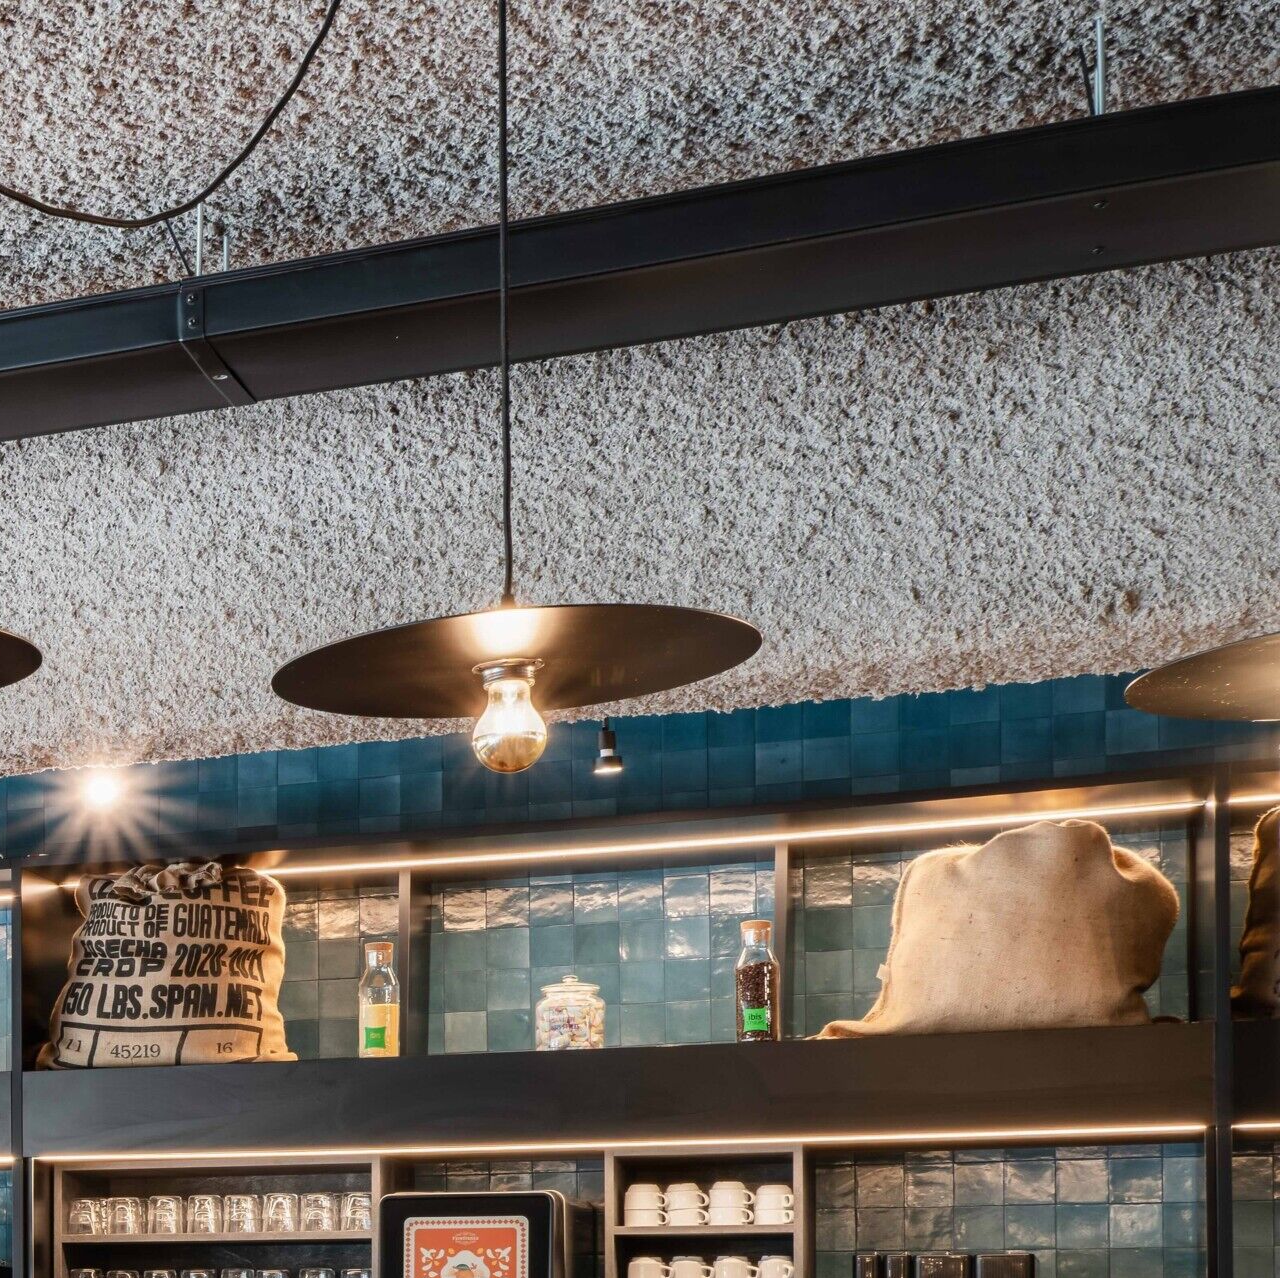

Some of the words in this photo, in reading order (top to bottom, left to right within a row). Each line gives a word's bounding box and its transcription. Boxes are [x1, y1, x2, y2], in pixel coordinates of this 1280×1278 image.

[79, 920, 140, 937] PRODUCT
[143, 921, 169, 938] OF
[89, 902, 140, 921] PRODUCTO
[144, 904, 170, 921] DE
[173, 903, 271, 946] GUATEMALA
[75, 958, 166, 977] CROP
[748, 1012, 763, 1021] ibis
[110, 1043, 161, 1059] 45219
[216, 1042, 233, 1054] 16
